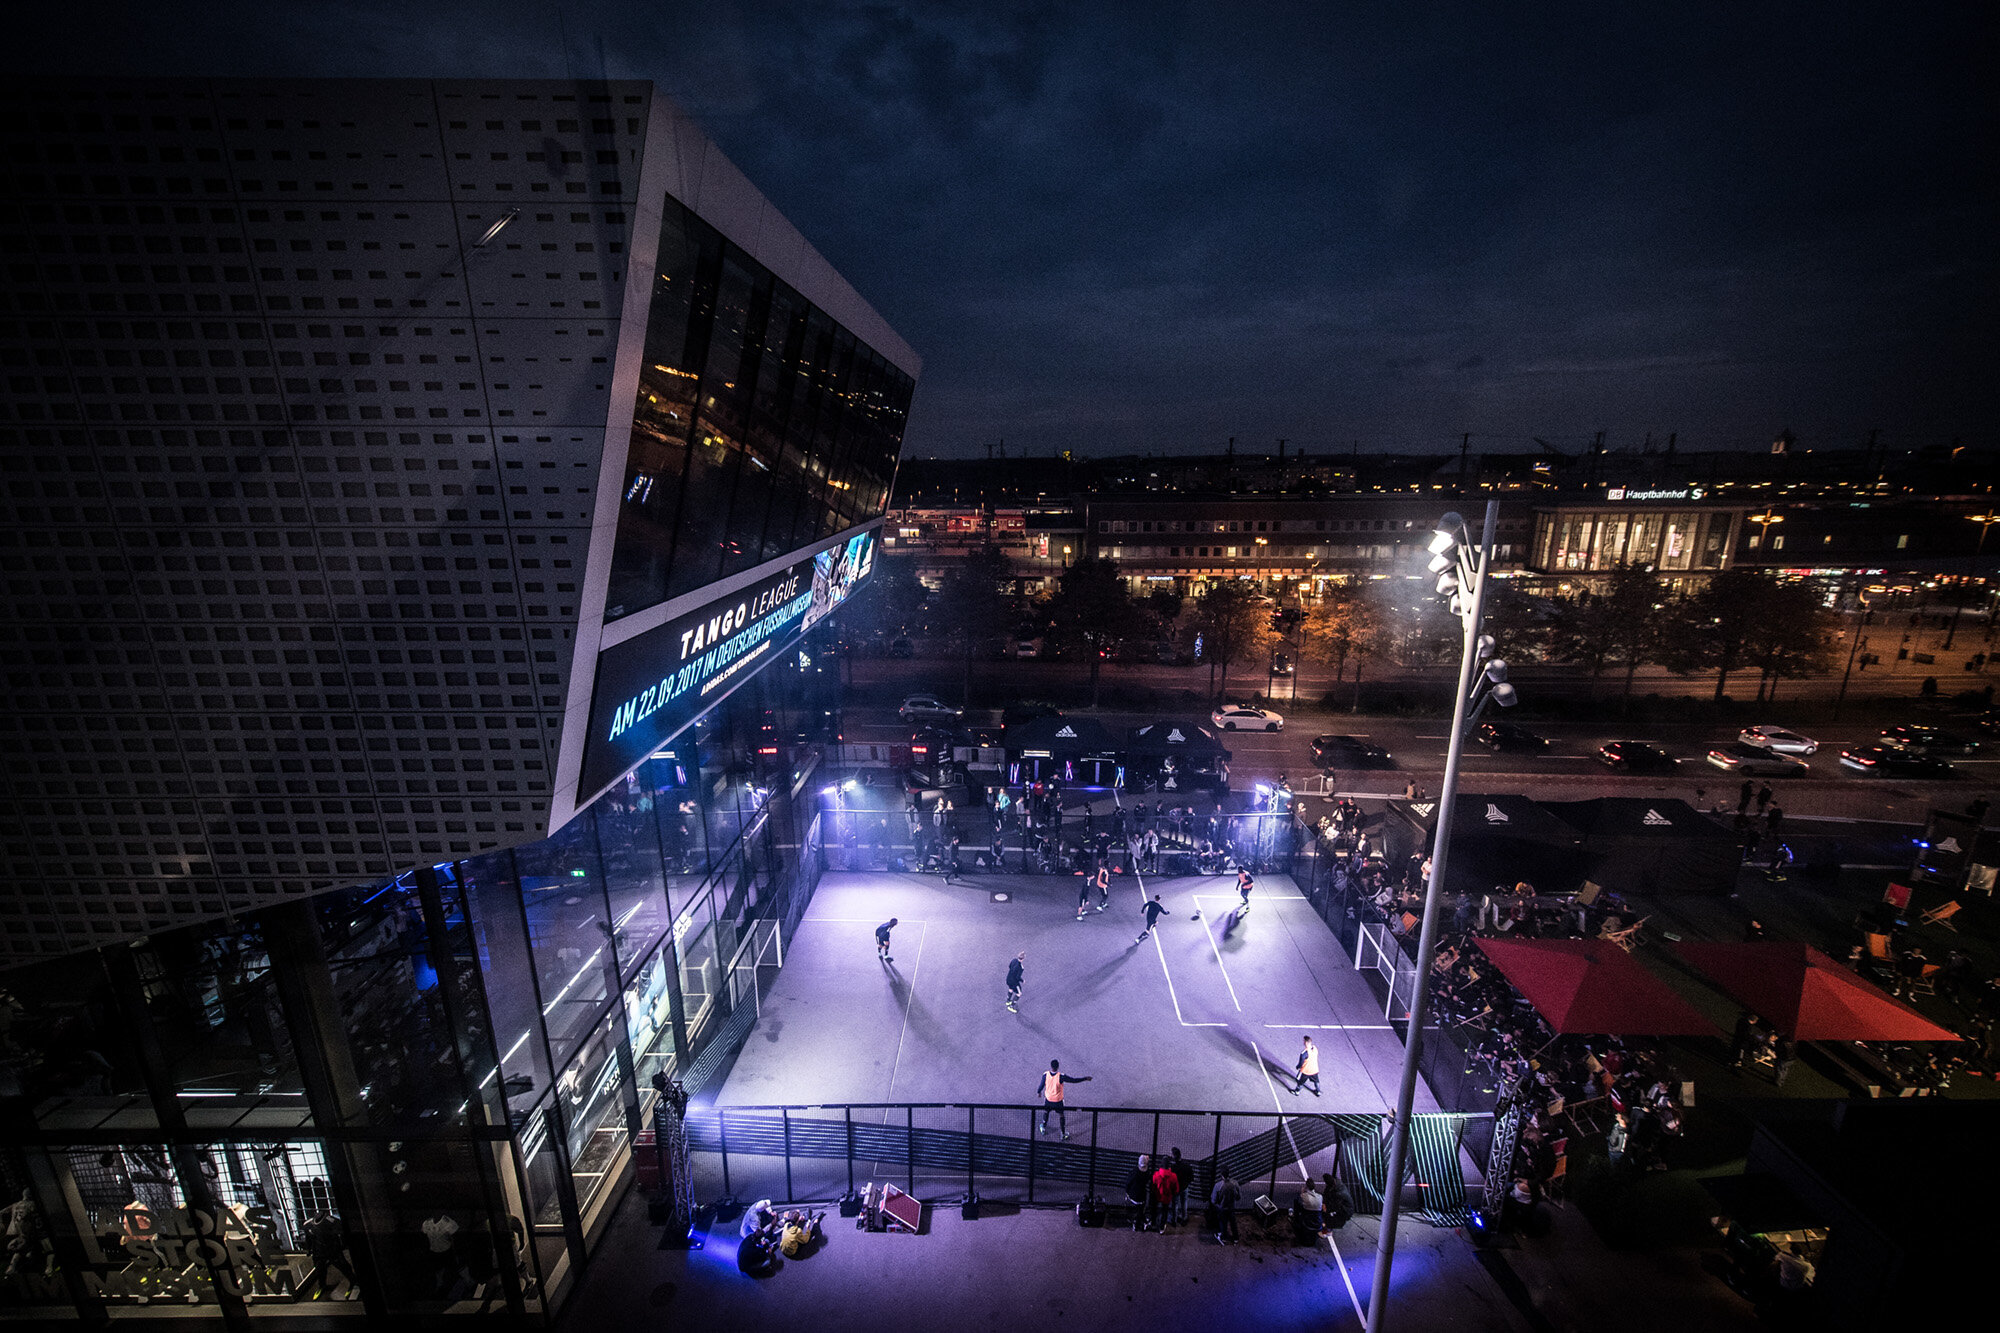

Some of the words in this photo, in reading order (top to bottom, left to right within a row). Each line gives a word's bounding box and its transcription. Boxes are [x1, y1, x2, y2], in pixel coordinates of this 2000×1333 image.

[1609, 490, 1623, 499] DB
[1626, 490, 1687, 500] Hauptbahnhof
[1691, 488, 1703, 500] S
[680, 603, 746, 660] TANGO
[751, 575, 799, 620] LEAGUE
[608, 696, 638, 741] AM
[637, 656, 704, 722] 22.09.2017
[702, 648, 717, 679] IM
[716, 620, 764, 669] DEUTSCHEN
[126, 1238, 288, 1268] STORE
